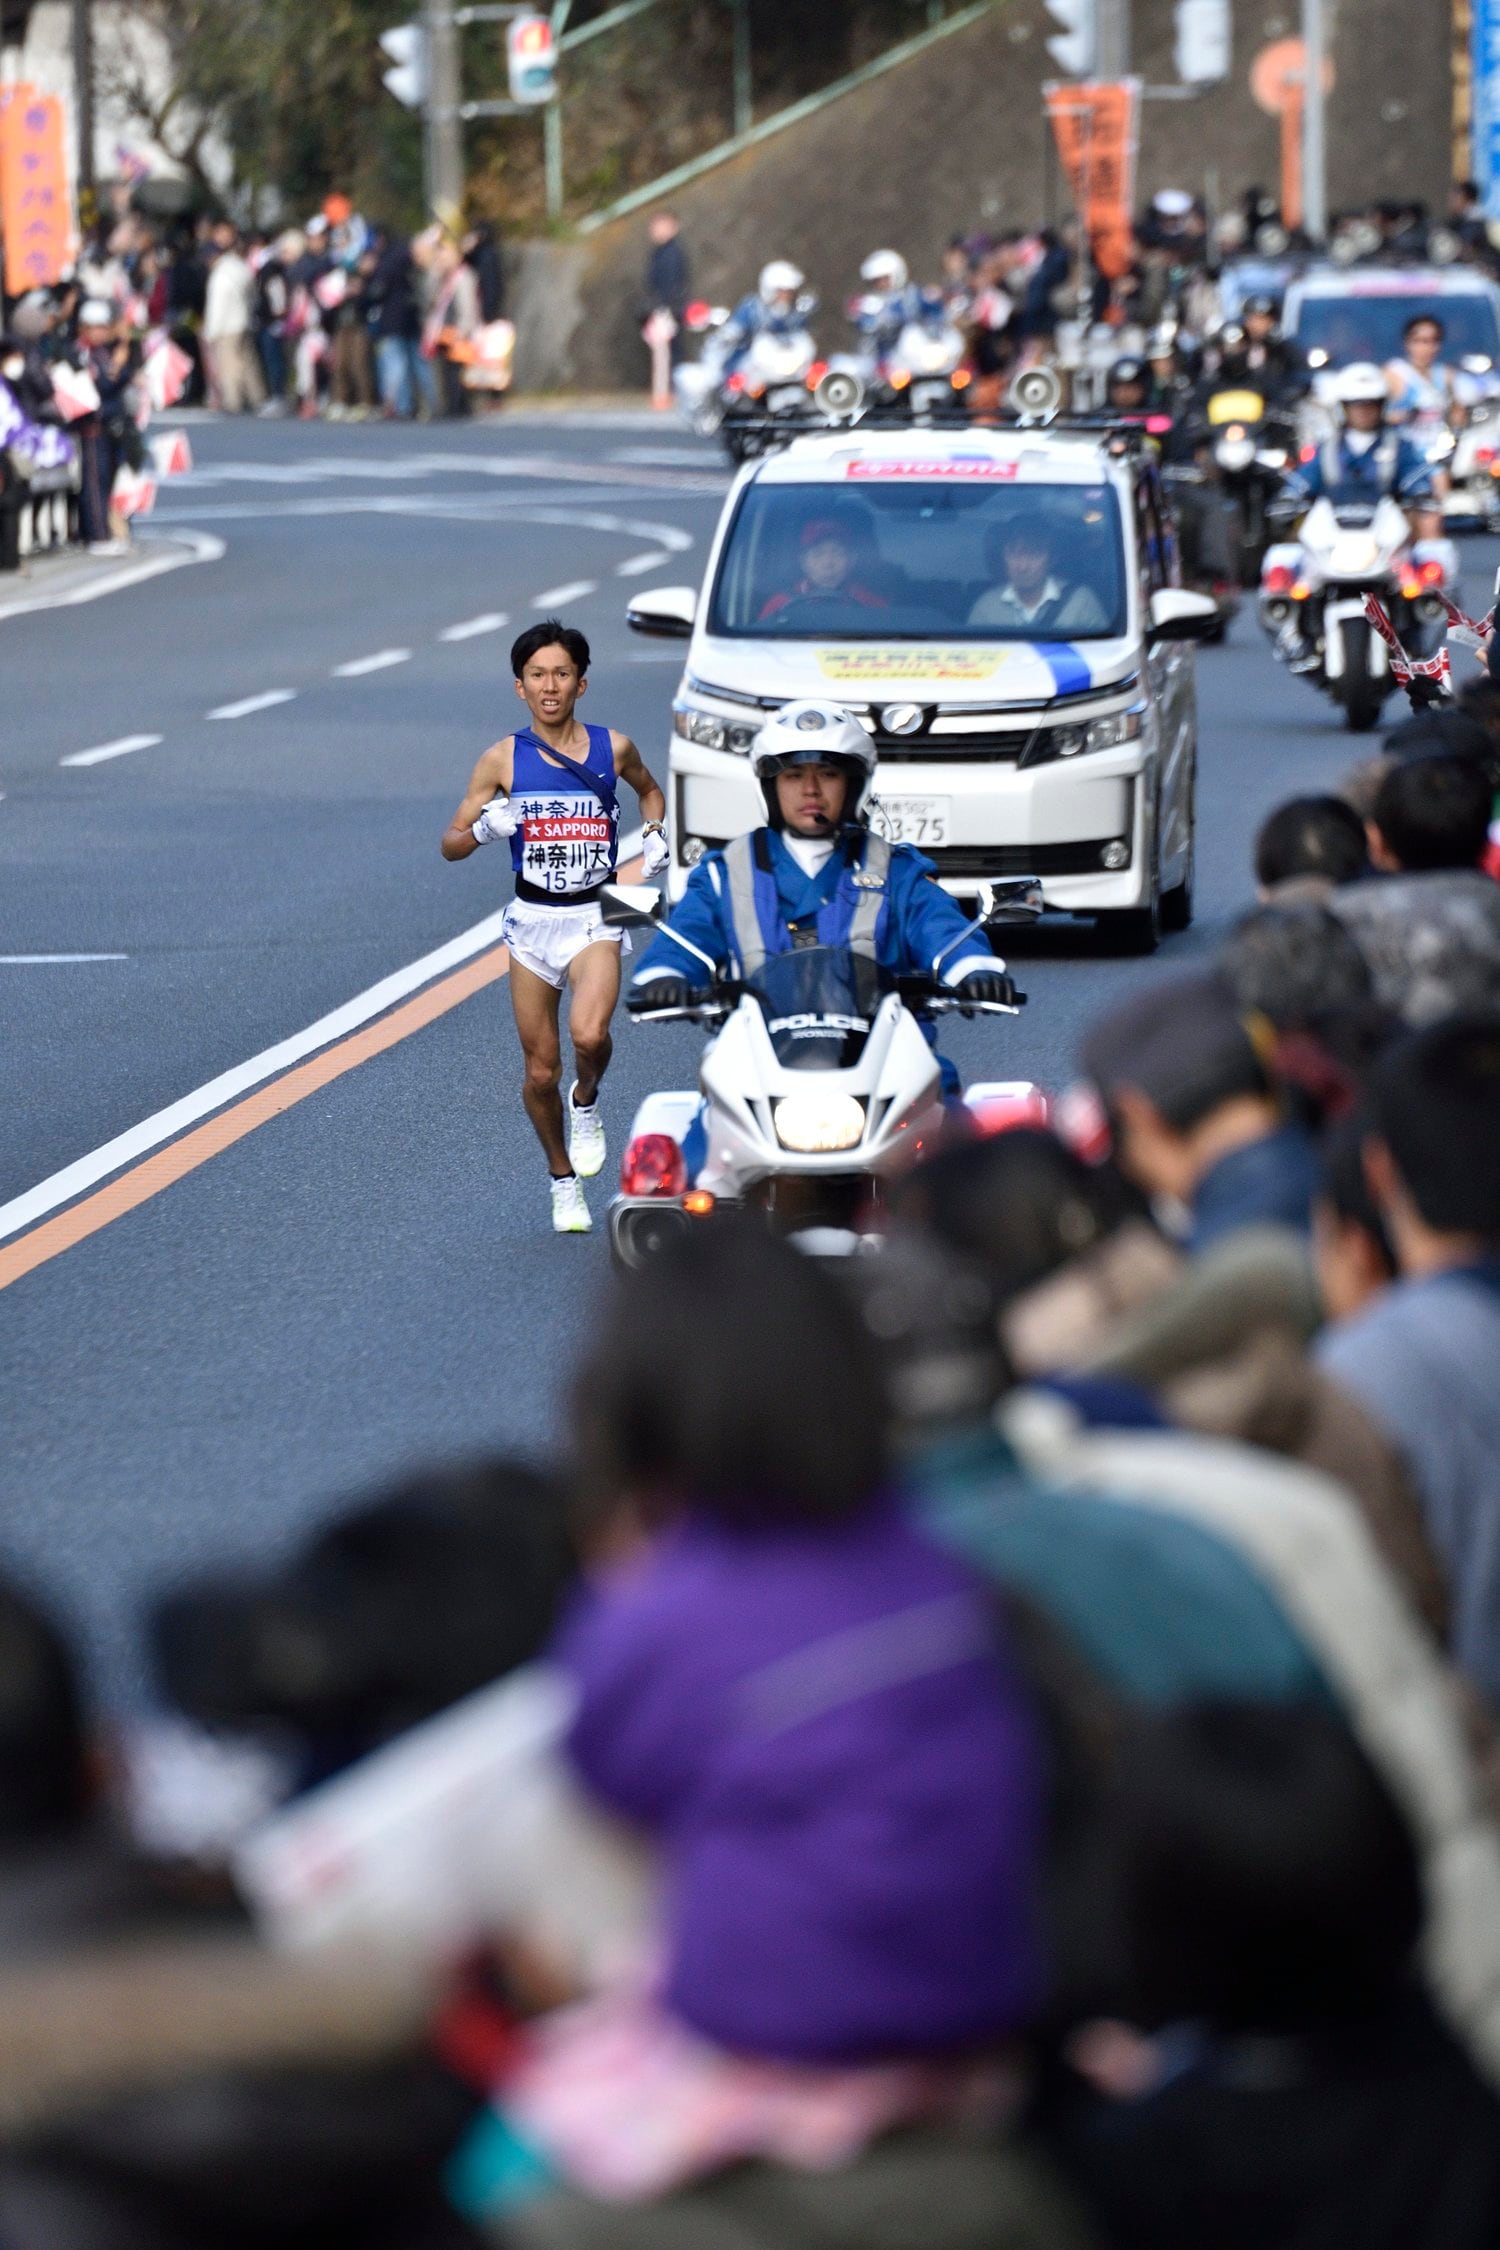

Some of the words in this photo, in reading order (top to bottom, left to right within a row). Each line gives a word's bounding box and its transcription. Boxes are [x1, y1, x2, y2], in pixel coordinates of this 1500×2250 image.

[544, 823, 607, 837] SAPPORO
[527, 843, 608, 869] 神奈川大
[542, 871, 594, 890] 15-2
[768, 1013, 869, 1034] POLICE
